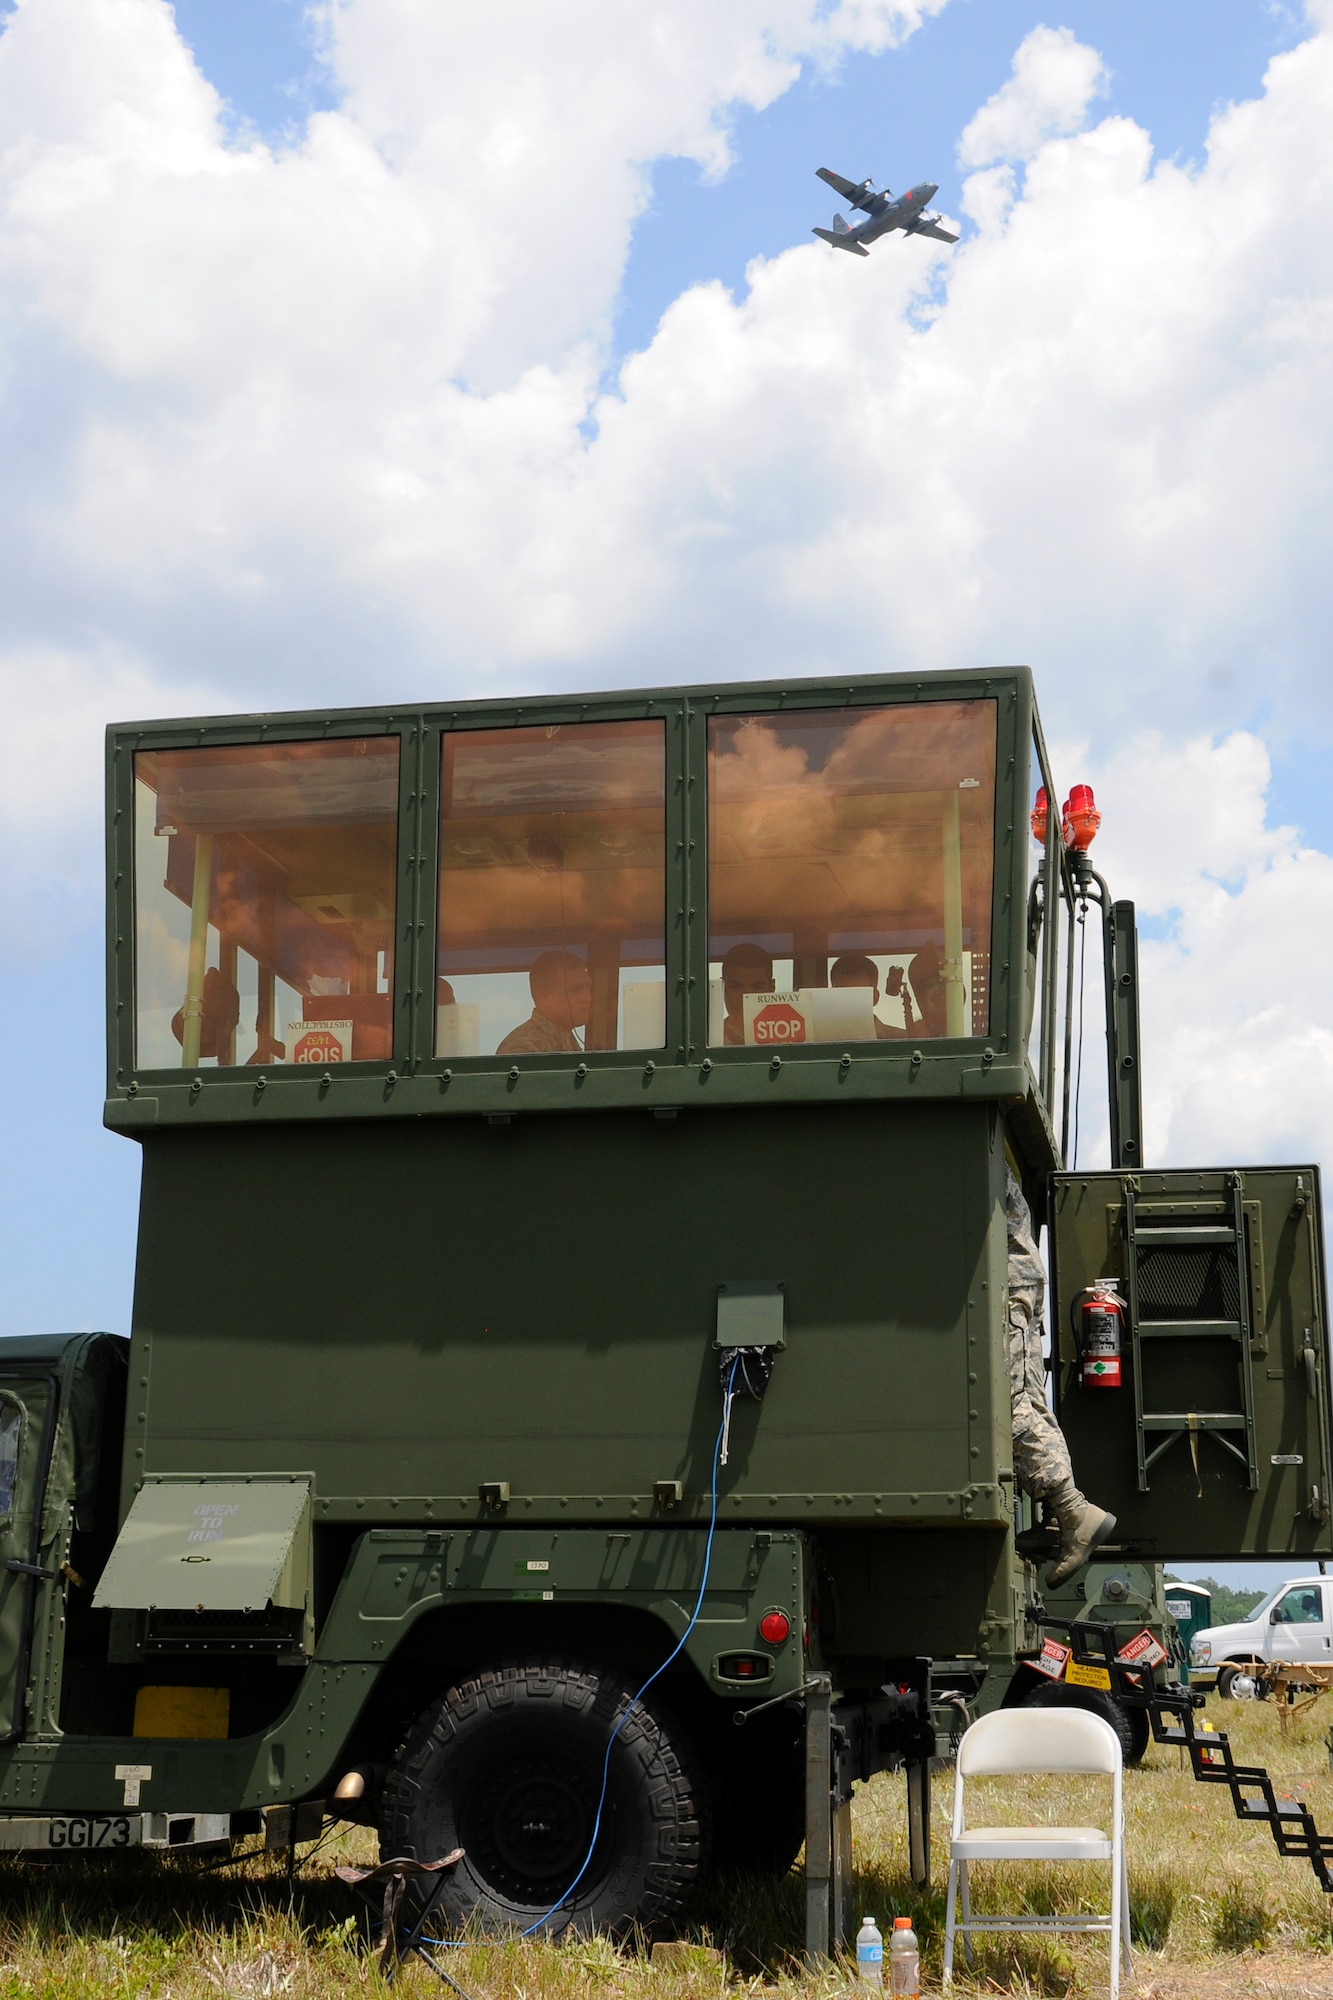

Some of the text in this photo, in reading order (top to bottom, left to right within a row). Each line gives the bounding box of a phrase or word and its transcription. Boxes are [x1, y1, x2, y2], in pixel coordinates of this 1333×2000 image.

[757, 994, 800, 1003] RUNWAY
[288, 1020, 353, 1030] OBSTRUCTION
[757, 1019, 802, 1040] STOP
[193, 1504, 240, 1517] OPEN
[201, 1517, 223, 1529] TO
[187, 1529, 224, 1542] RUN
[1071, 1670, 1107, 1681] PROTECTION
[48, 1818, 130, 1848] GG173
